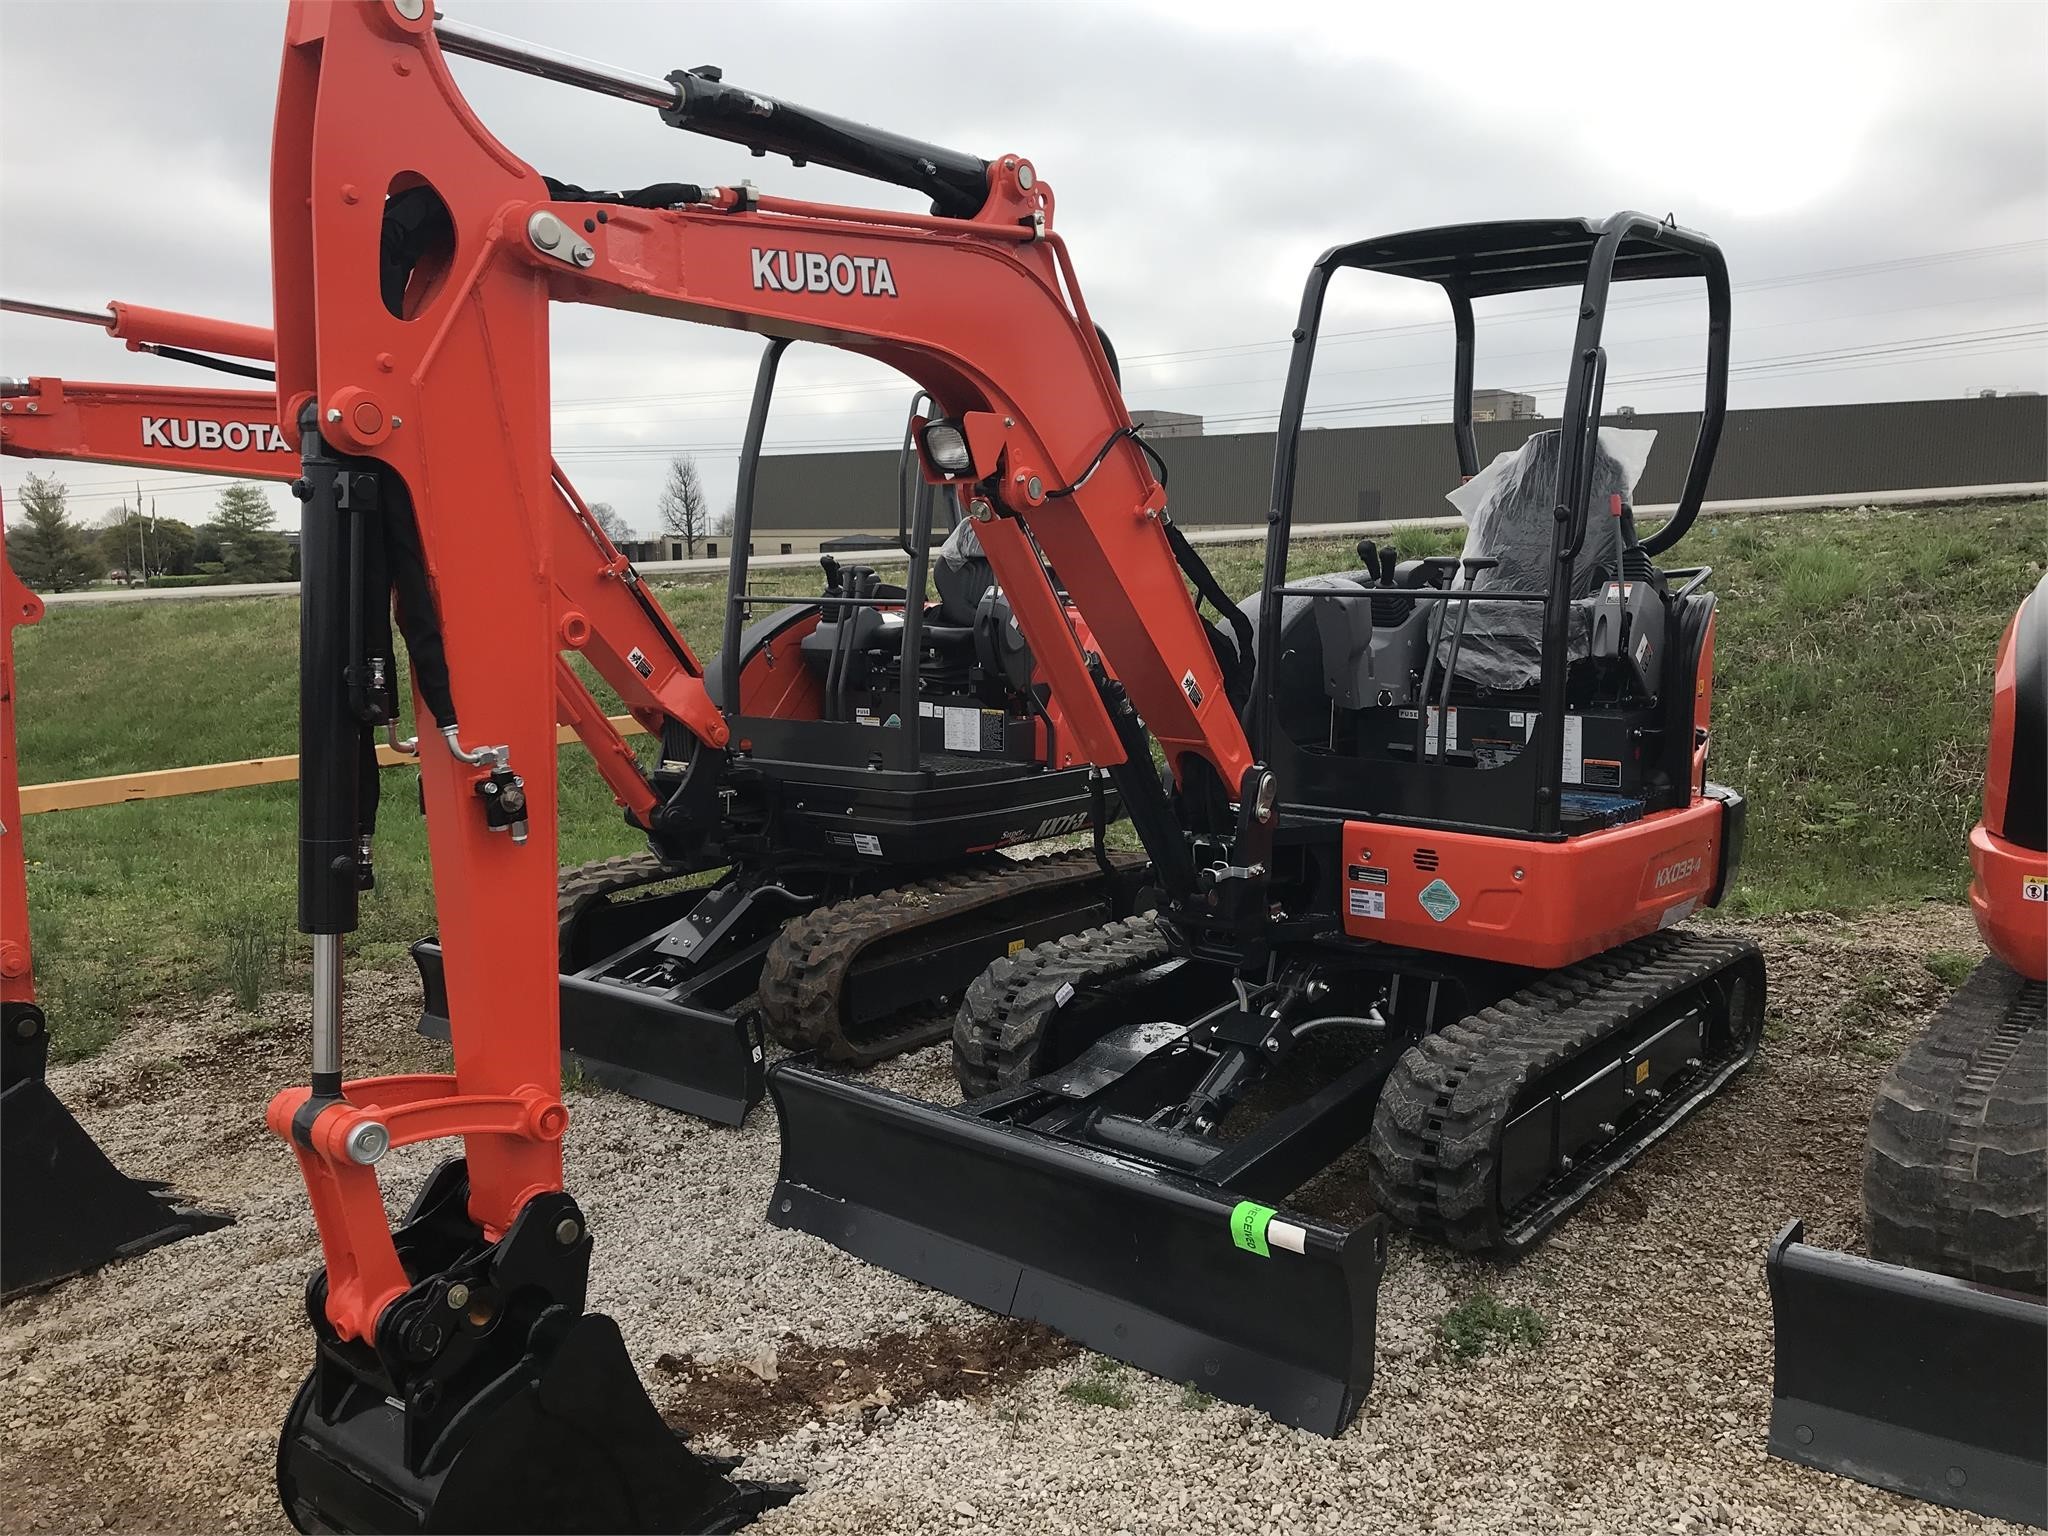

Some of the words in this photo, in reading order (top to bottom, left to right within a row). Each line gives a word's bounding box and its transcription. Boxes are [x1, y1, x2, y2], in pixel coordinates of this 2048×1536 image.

[751, 248, 898, 297] KUBOTA
[141, 416, 292, 452] KUBOTA
[1001, 829, 1025, 840] Super
[1033, 811, 1088, 839] KX71-3
[1655, 856, 1702, 888] KX033-4
[1243, 1206, 1264, 1249] RECEIVED
